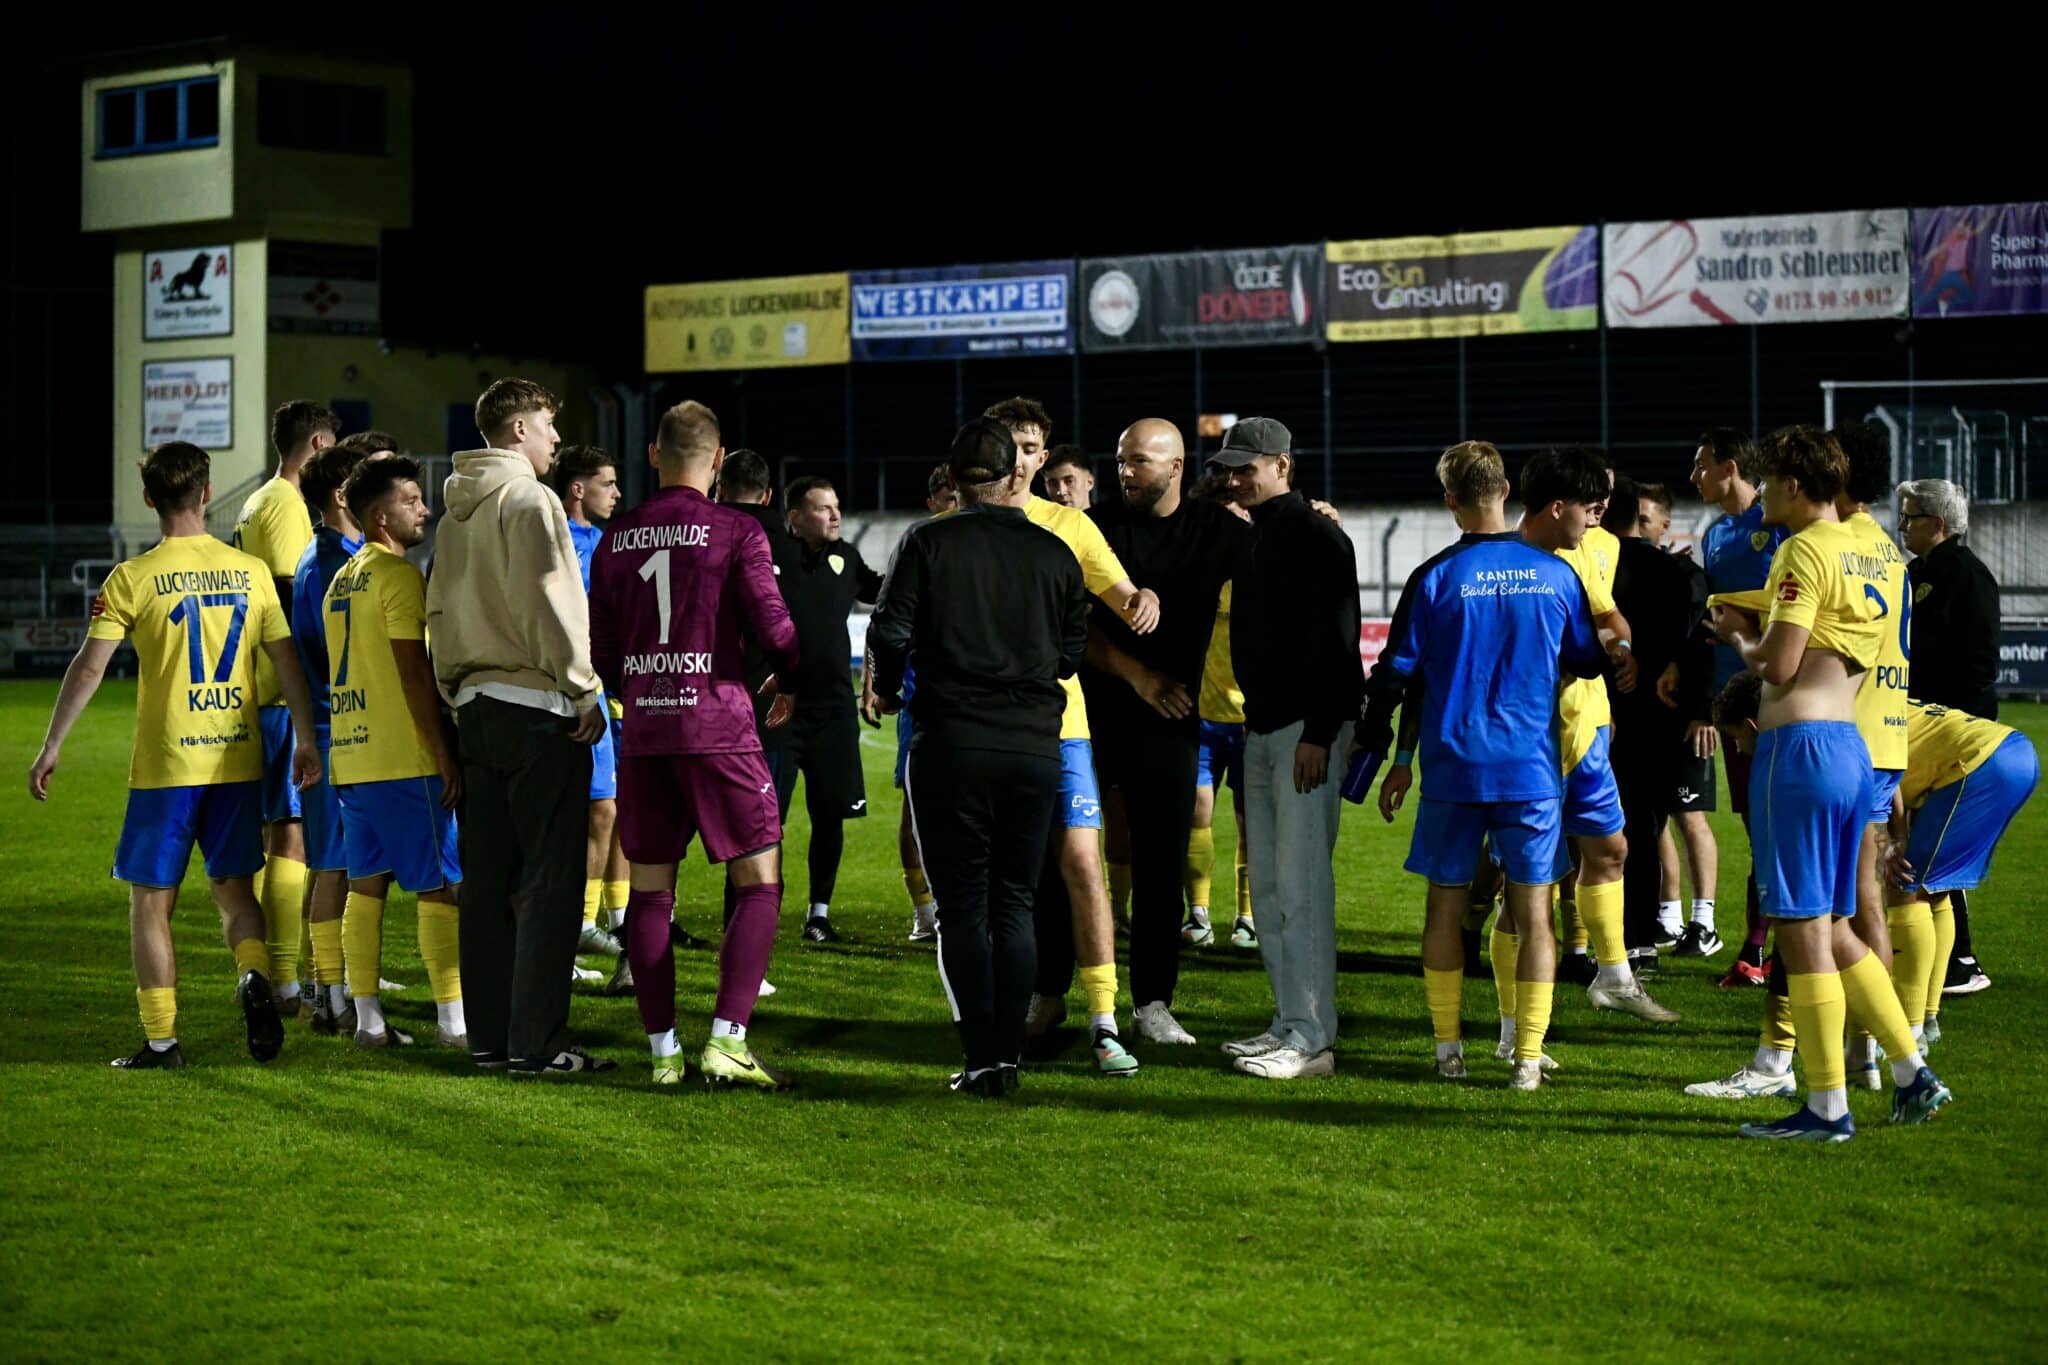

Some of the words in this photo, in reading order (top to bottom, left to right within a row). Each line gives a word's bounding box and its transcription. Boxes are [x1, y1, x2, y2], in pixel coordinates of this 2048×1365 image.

[1696, 253, 1773, 282] Sandro
[1780, 248, 1902, 277] Schleusner
[1371, 276, 1506, 311] Consulting
[611, 524, 711, 553] LUCKENWALDE
[154, 569, 252, 597] LUCKENWALDE
[1476, 568, 1538, 582] KANTINE
[638, 549, 672, 645] 1
[1460, 582, 1498, 598] Bärbel
[1500, 581, 1556, 596] Schneider
[168, 593, 249, 685] 17
[186, 686, 243, 712] KAUS
[635, 696, 679, 707] Märkischer
[680, 695, 698, 706] Hof
[180, 734, 235, 748] Märkischer
[353, 733, 370, 746] Hof
